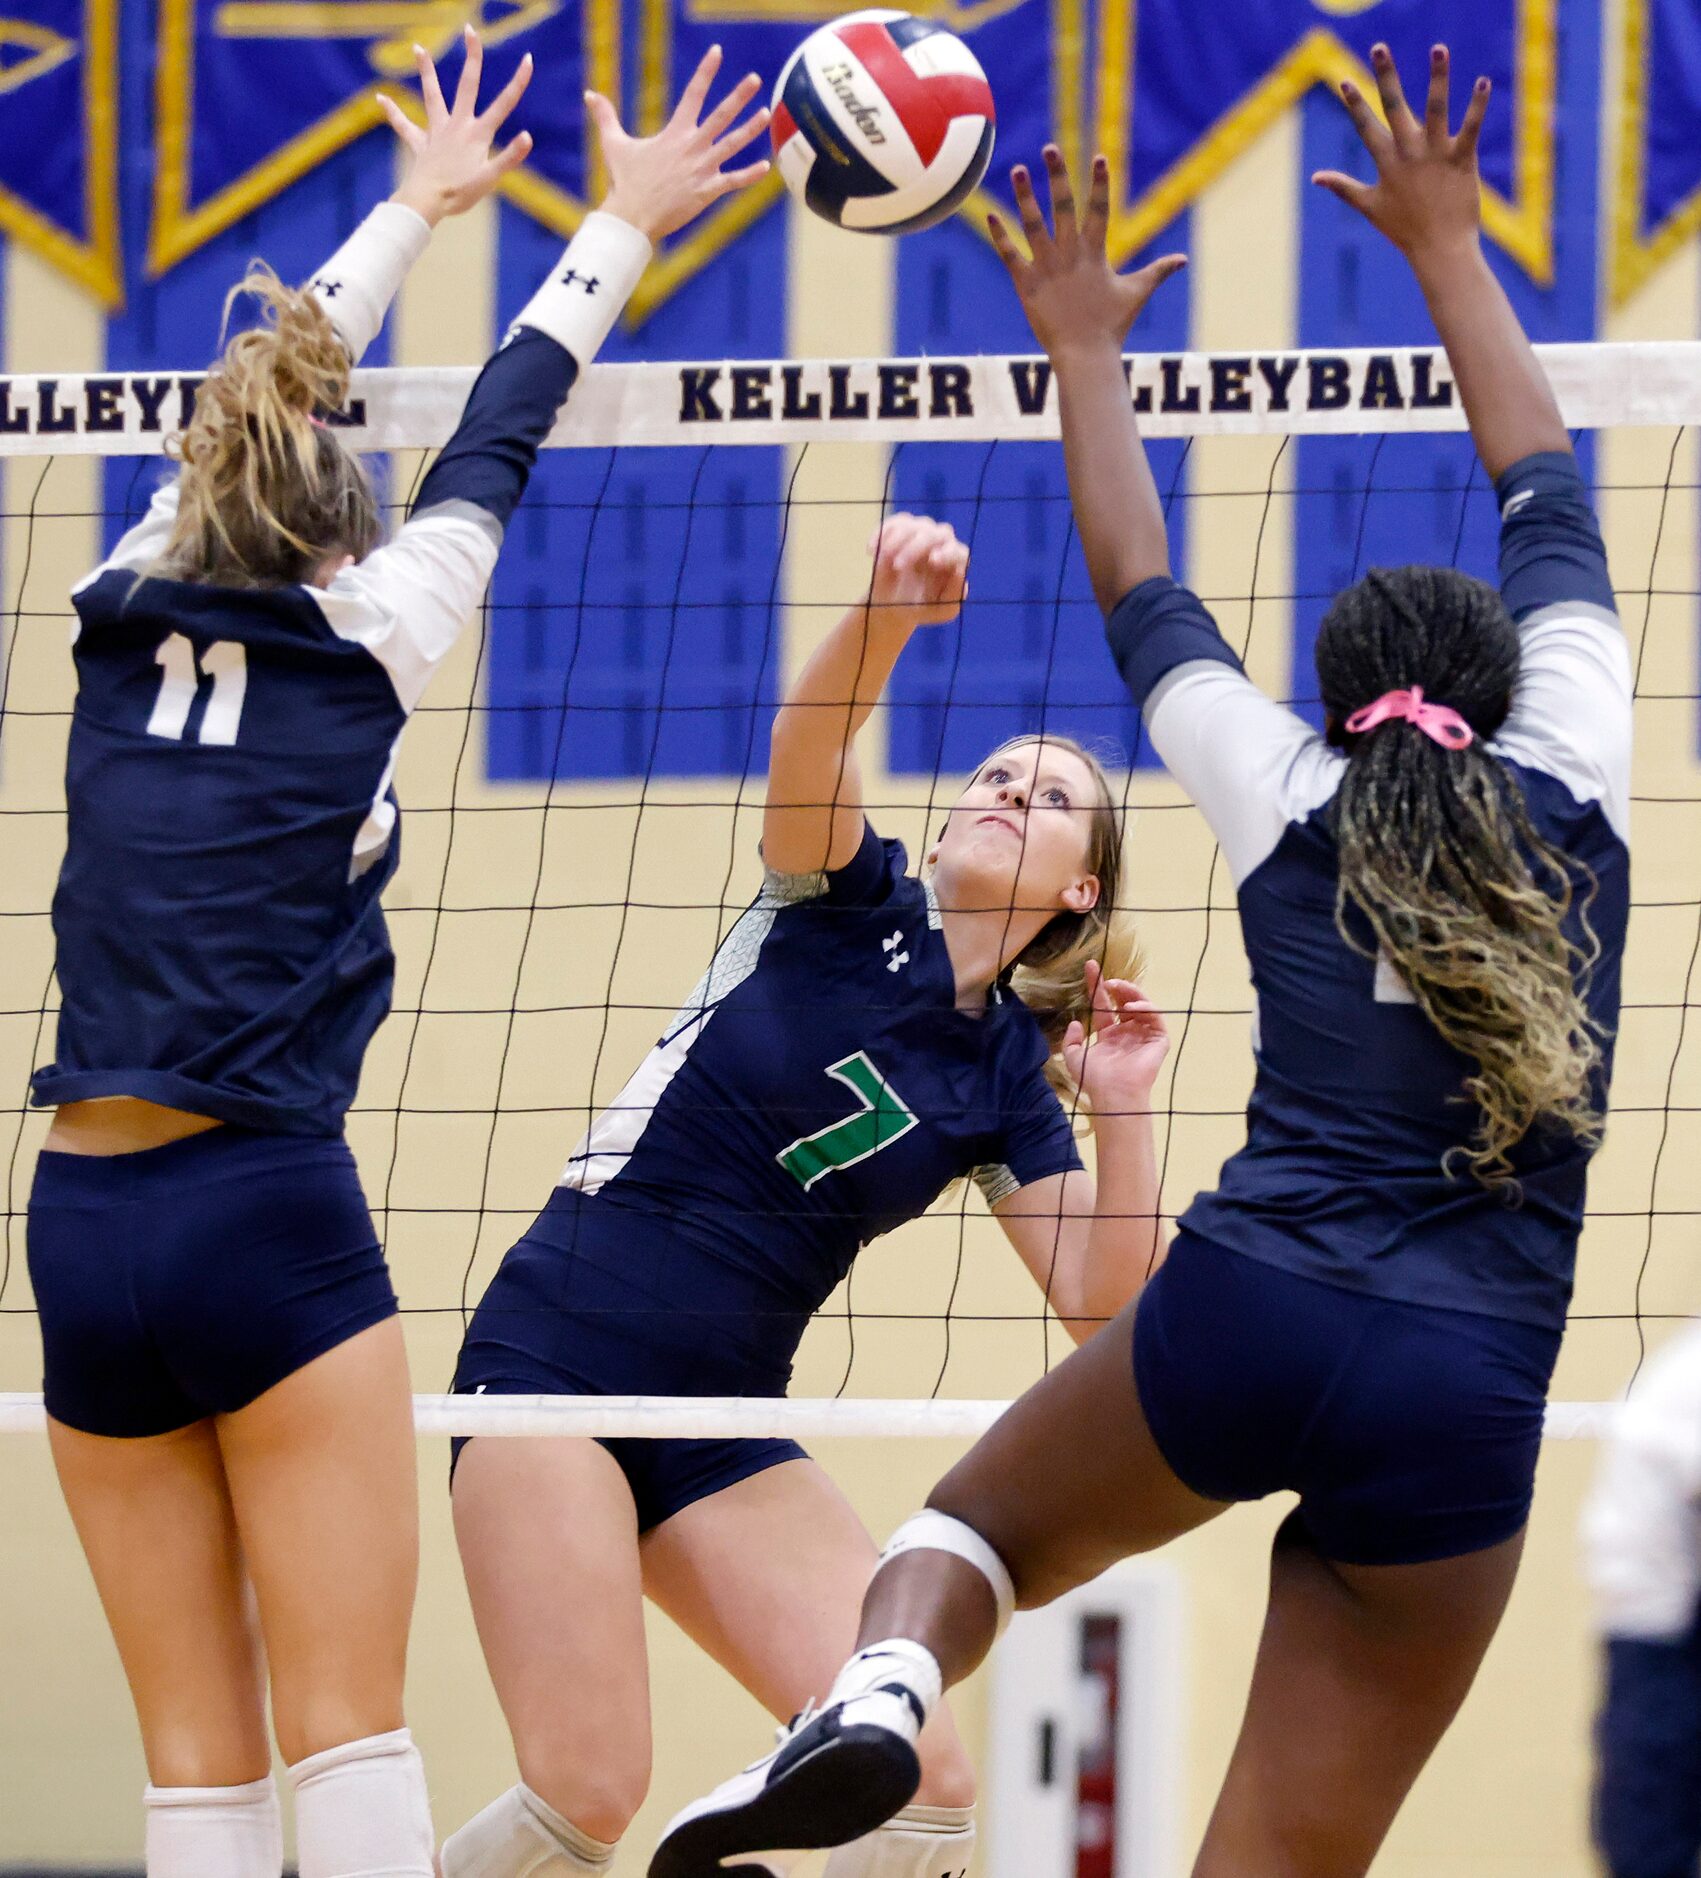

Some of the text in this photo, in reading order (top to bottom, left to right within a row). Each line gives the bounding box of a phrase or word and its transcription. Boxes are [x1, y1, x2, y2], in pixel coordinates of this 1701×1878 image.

[680, 363, 974, 423] KELLER
[146, 631, 248, 746] 11
[775, 1050, 920, 1192] 7
